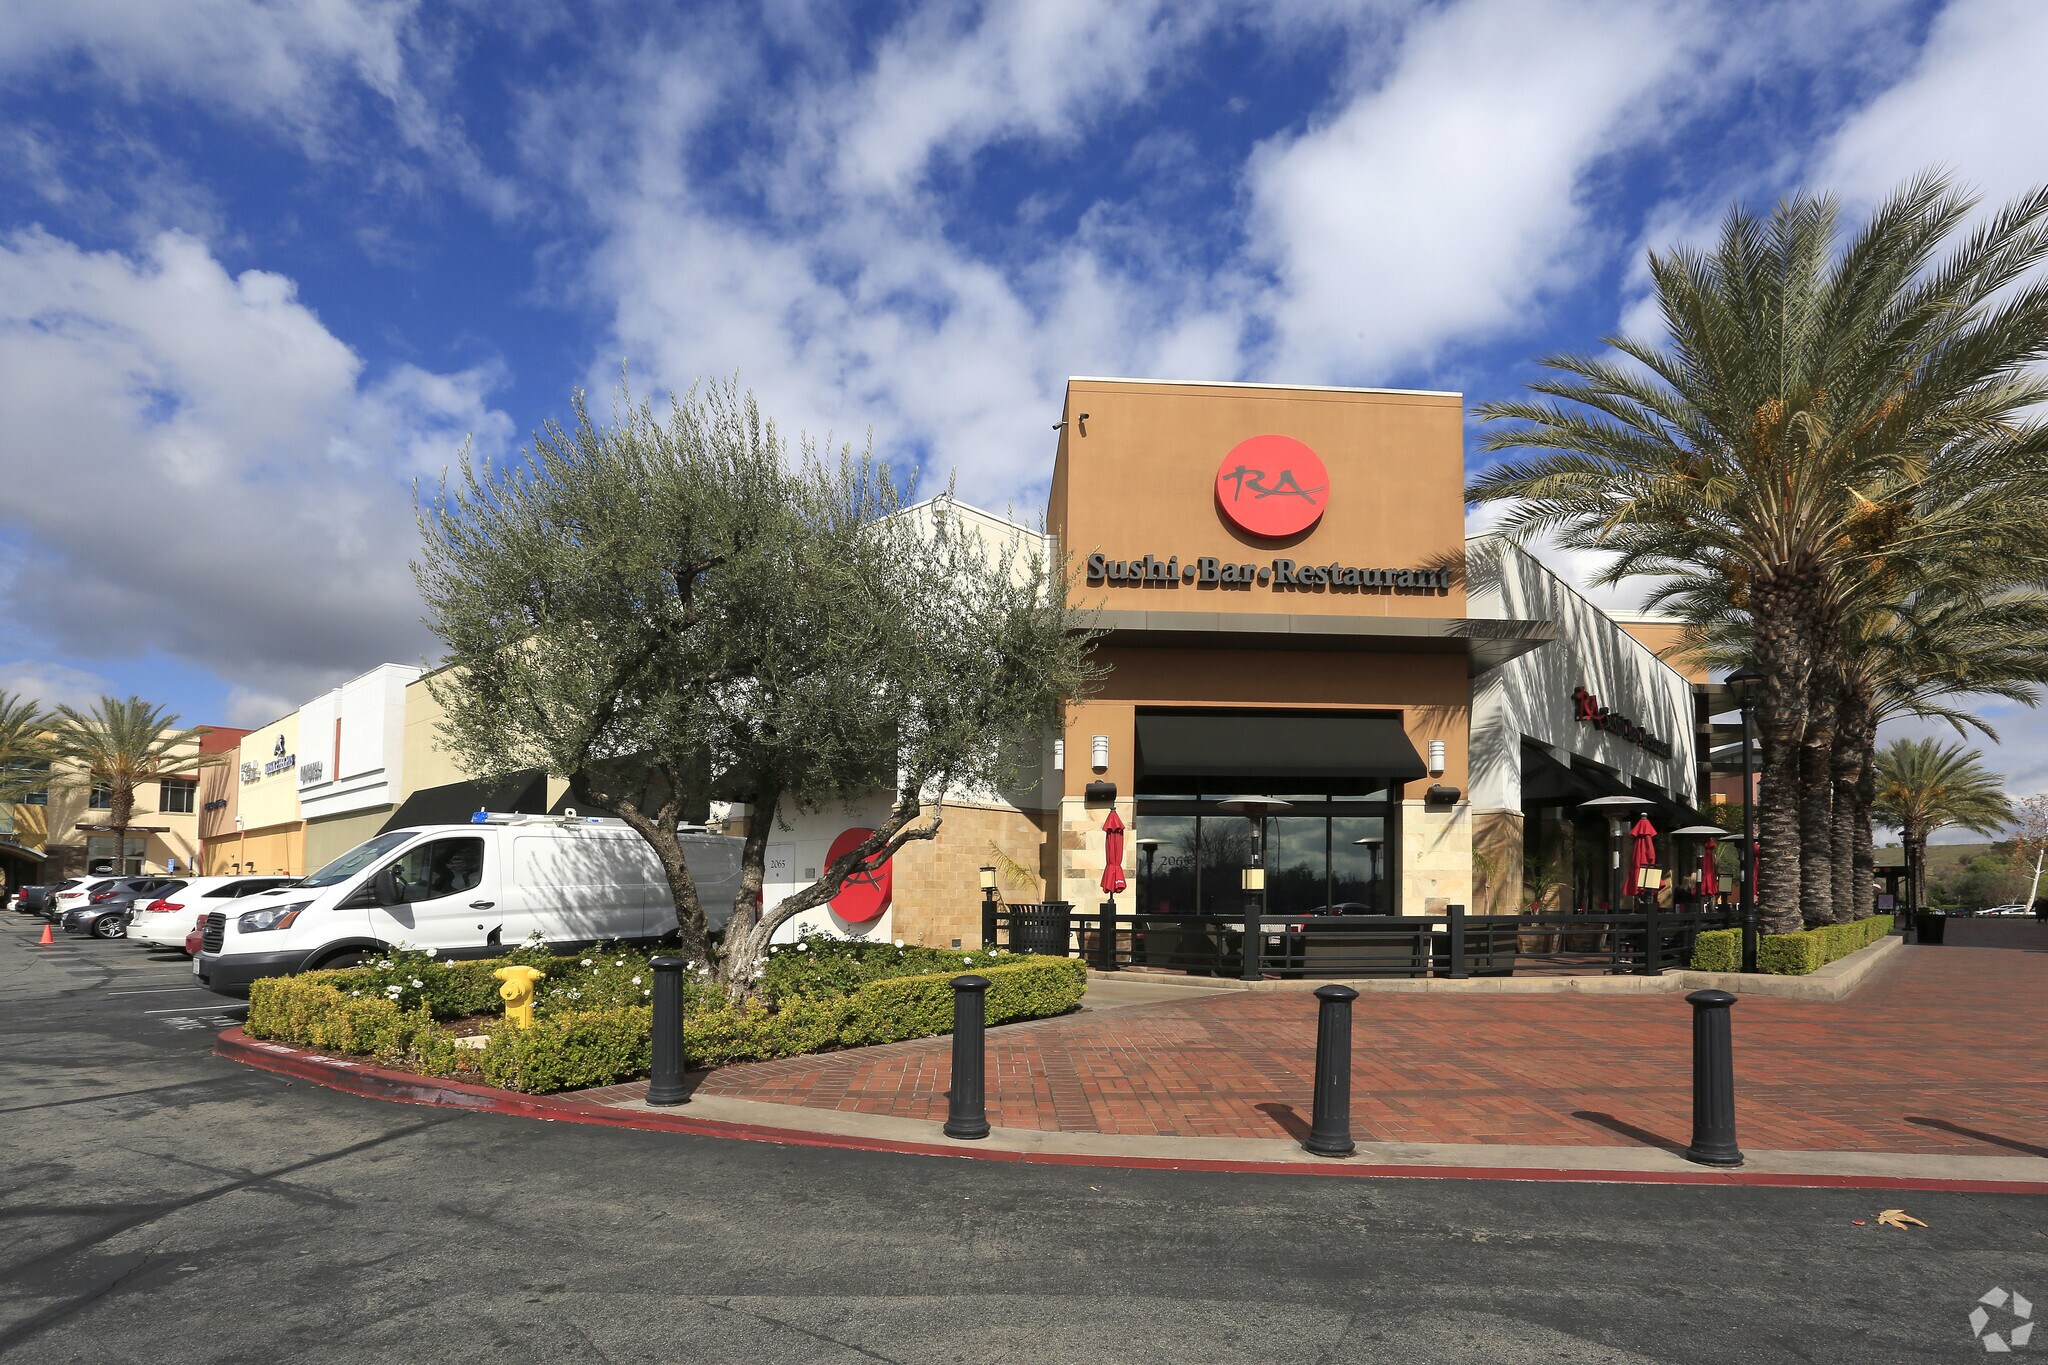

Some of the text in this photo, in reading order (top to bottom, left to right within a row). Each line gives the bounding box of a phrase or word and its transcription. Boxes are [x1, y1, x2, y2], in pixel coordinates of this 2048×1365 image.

[1222, 464, 1326, 506] RA
[1085, 553, 1451, 590] Sushi Bar Restaurant
[770, 859, 786, 869] 2065
